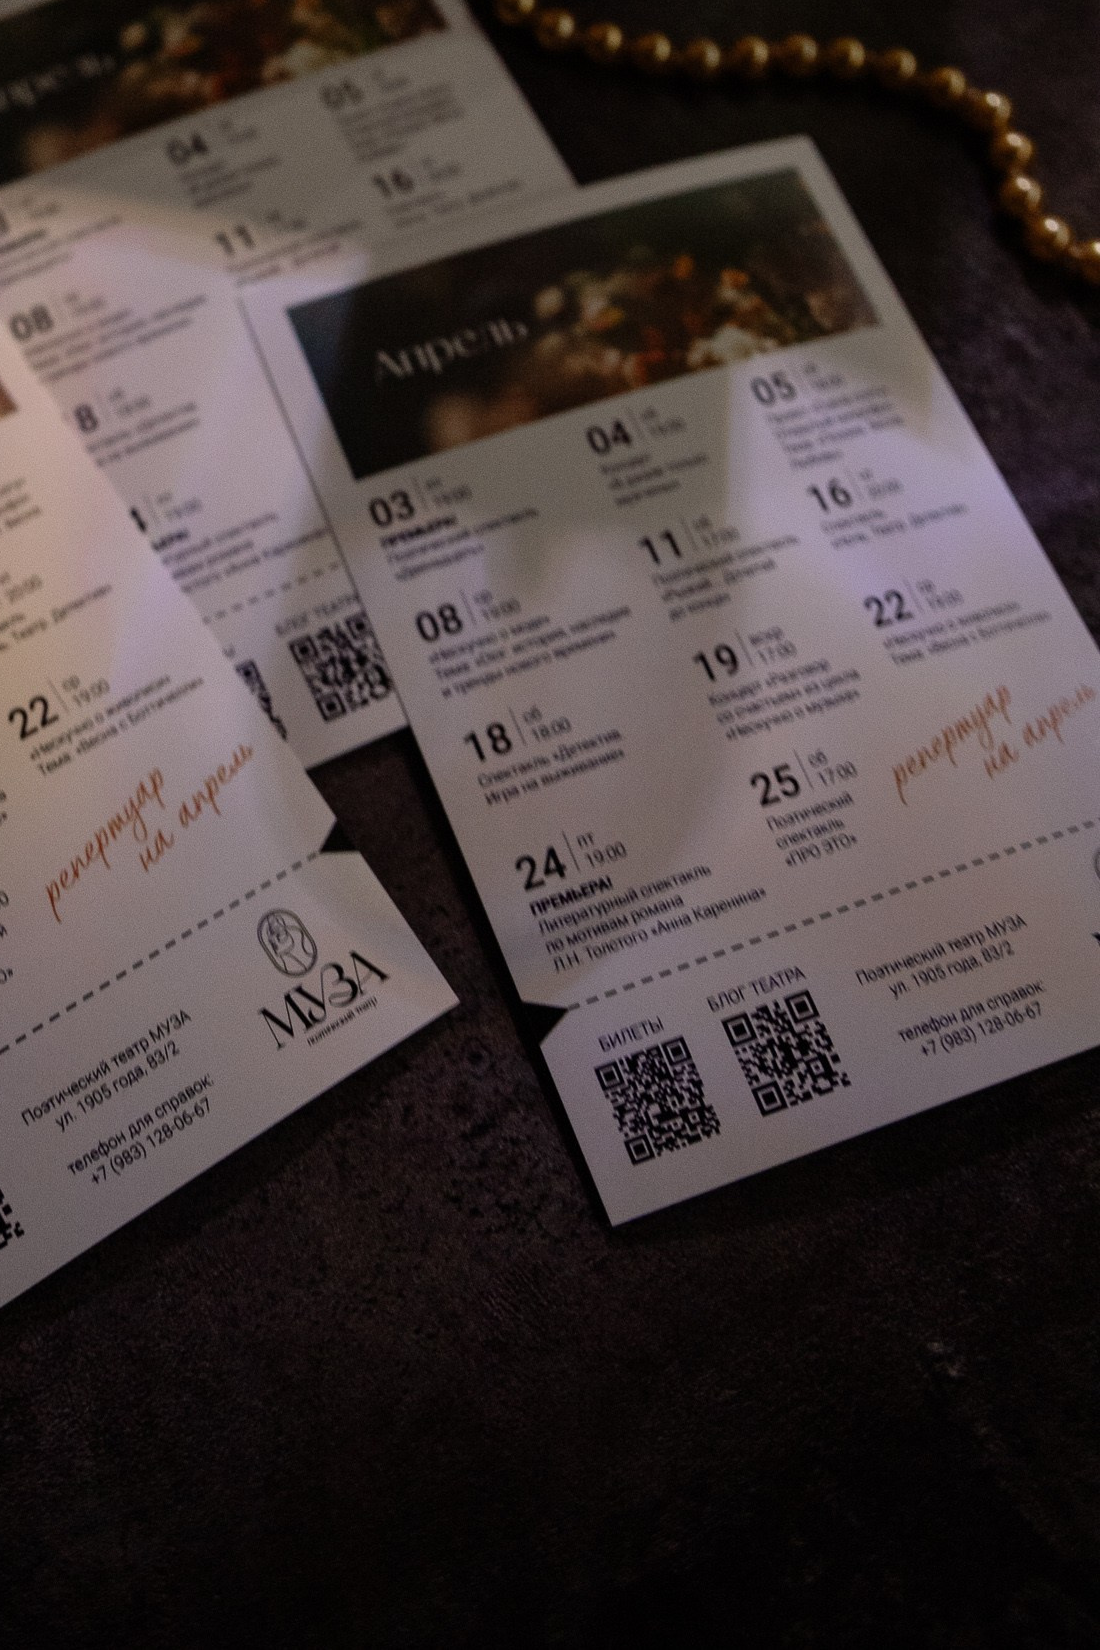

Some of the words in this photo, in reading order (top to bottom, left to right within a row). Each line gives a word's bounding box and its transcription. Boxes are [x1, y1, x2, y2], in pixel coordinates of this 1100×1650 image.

[166, 133, 208, 167] 04
[372, 168, 416, 198] 16
[212, 225, 255, 256] 11
[10, 307, 53, 342] 08
[374, 316, 530, 387] Апрель
[748, 369, 798, 408] 05
[584, 418, 633, 456] 04
[366, 488, 416, 529] 03
[805, 476, 854, 514] 16
[637, 528, 682, 566] 11
[412, 601, 464, 644] 08
[862, 587, 913, 629] 22
[691, 642, 741, 684] 19
[5, 692, 60, 741] 22
[462, 720, 514, 764] 18
[748, 762, 802, 808] 25
[816, 759, 858, 787] 17:00
[138, 827, 175, 873] на
[178, 744, 253, 828] апрель
[764, 790, 854, 831] Поэтический
[45, 768, 166, 924] репертуар
[575, 831, 595, 848] пт
[584, 840, 627, 868] 19:00
[774, 817, 845, 850] спектакль
[512, 844, 568, 892] 24
[528, 874, 614, 916] ПРЕМЬЕРА!
[536, 887, 640, 936] Литературный
[638, 863, 712, 898] спектакль
[544, 937, 564, 953] по
[564, 913, 629, 945] мотивам
[628, 894, 685, 925] романа
[584, 928, 649, 960] Толстого
[854, 942, 947, 986] Поэтический
[945, 930, 987, 955] театр
[983, 912, 1027, 939] МУЗА
[887, 979, 909, 1000] ул.
[910, 963, 946, 987] 1905
[945, 953, 983, 977] года,
[979, 939, 1015, 963] 83/2
[258, 950, 388, 1049] МУЗА
[705, 984, 748, 1012] БЛОГ
[749, 964, 806, 996] ТЕАТРА
[897, 1011, 959, 1043] телефон
[958, 1001, 986, 1023] для
[985, 980, 1046, 1012] справок:
[919, 1038, 938, 1057] +7
[936, 1024, 978, 1054] (983)
[975, 1000, 1043, 1036] 128-06-67
[597, 1015, 665, 1052] БИЛЕТЫ
[19, 1059, 111, 1126] Поэтический
[109, 1035, 151, 1069] театр
[147, 1008, 192, 1043] МУЗА
[54, 1108, 76, 1132] ул.
[75, 1082, 113, 1114] 1905
[110, 1062, 149, 1094] года,
[144, 1039, 180, 1071] 83/2
[66, 1129, 128, 1177] телефон
[125, 1111, 155, 1140] для
[152, 1073, 214, 1120] справок:
[89, 1164, 109, 1186] +7
[108, 1140, 148, 1176] (983)
[145, 1095, 213, 1149] 128-06-67
